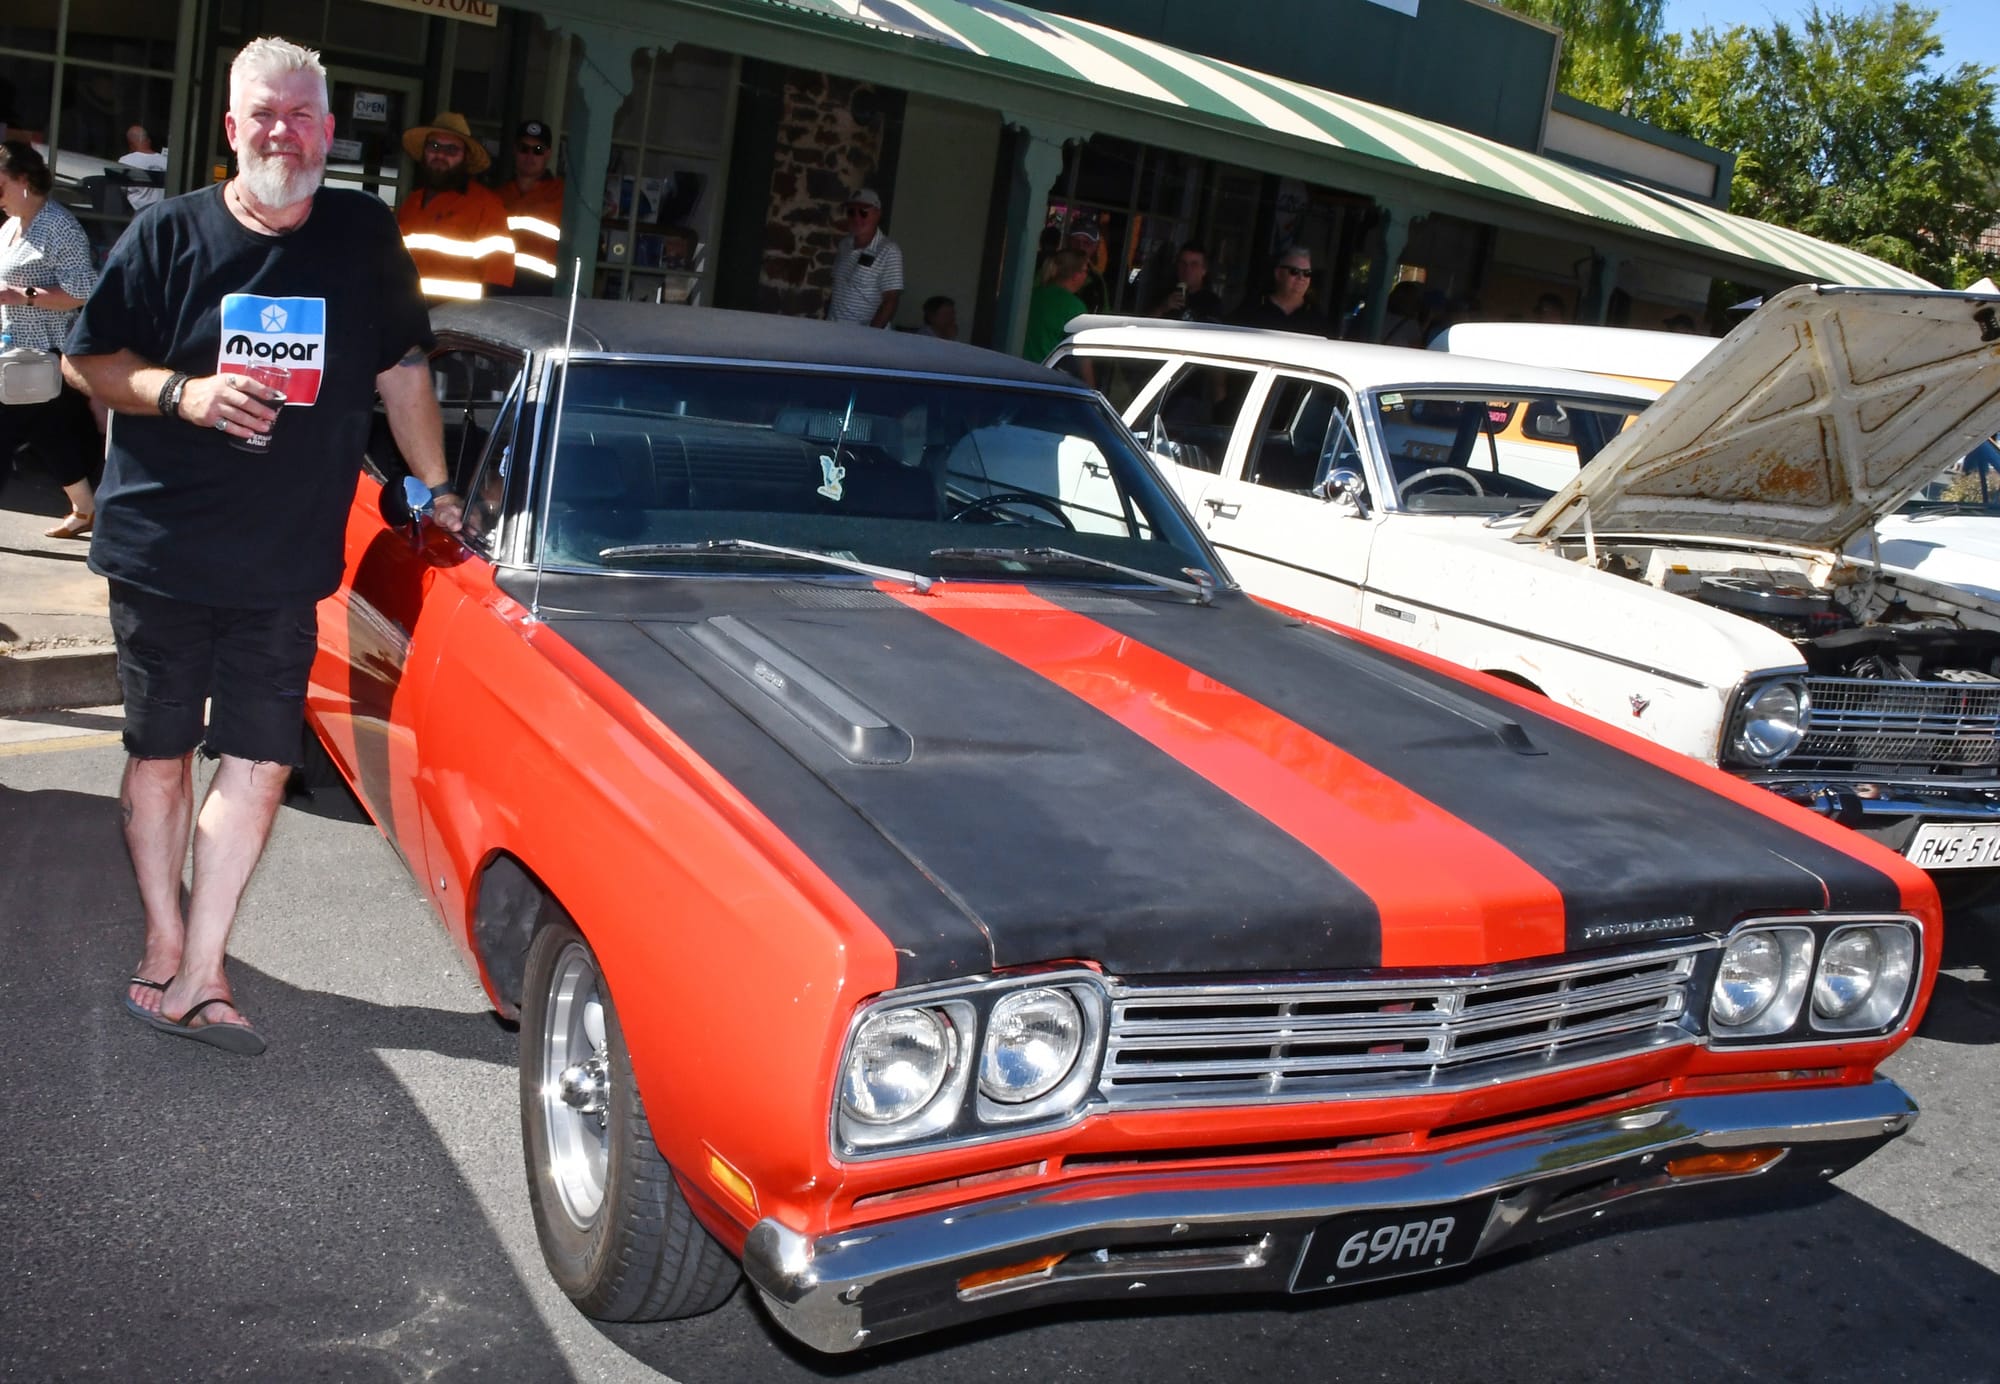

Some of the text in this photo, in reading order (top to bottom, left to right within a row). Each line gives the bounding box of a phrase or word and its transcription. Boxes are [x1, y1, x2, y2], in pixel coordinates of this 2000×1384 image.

[421, 0, 493, 18] ORE
[356, 100, 385, 113] OPEN
[226, 335, 318, 363] Mopar
[1336, 1216, 1456, 1269] 69RR
